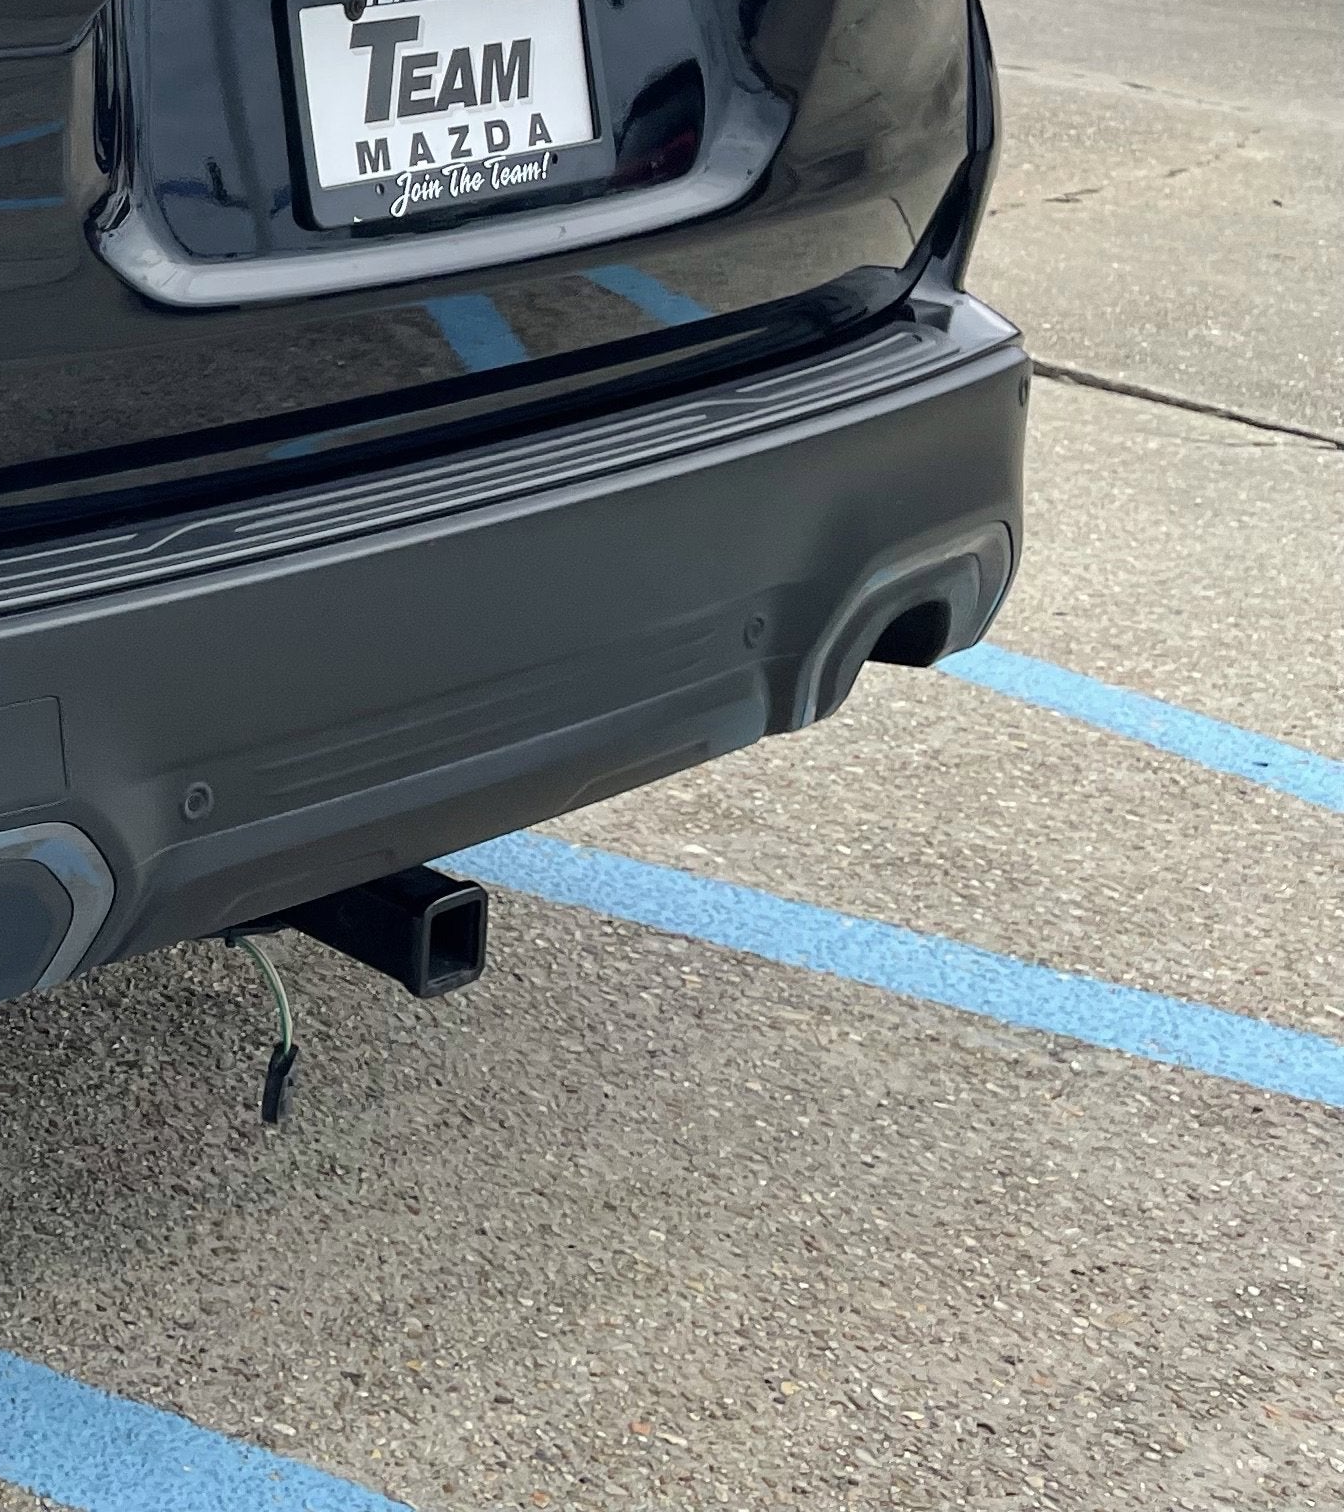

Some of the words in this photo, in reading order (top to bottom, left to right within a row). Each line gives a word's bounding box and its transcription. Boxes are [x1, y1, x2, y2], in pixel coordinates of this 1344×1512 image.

[349, 15, 533, 125] TEAM
[355, 112, 553, 176] MAZDA
[390, 170, 443, 218] Join
[442, 163, 486, 198] The
[484, 151, 550, 190] Team!
